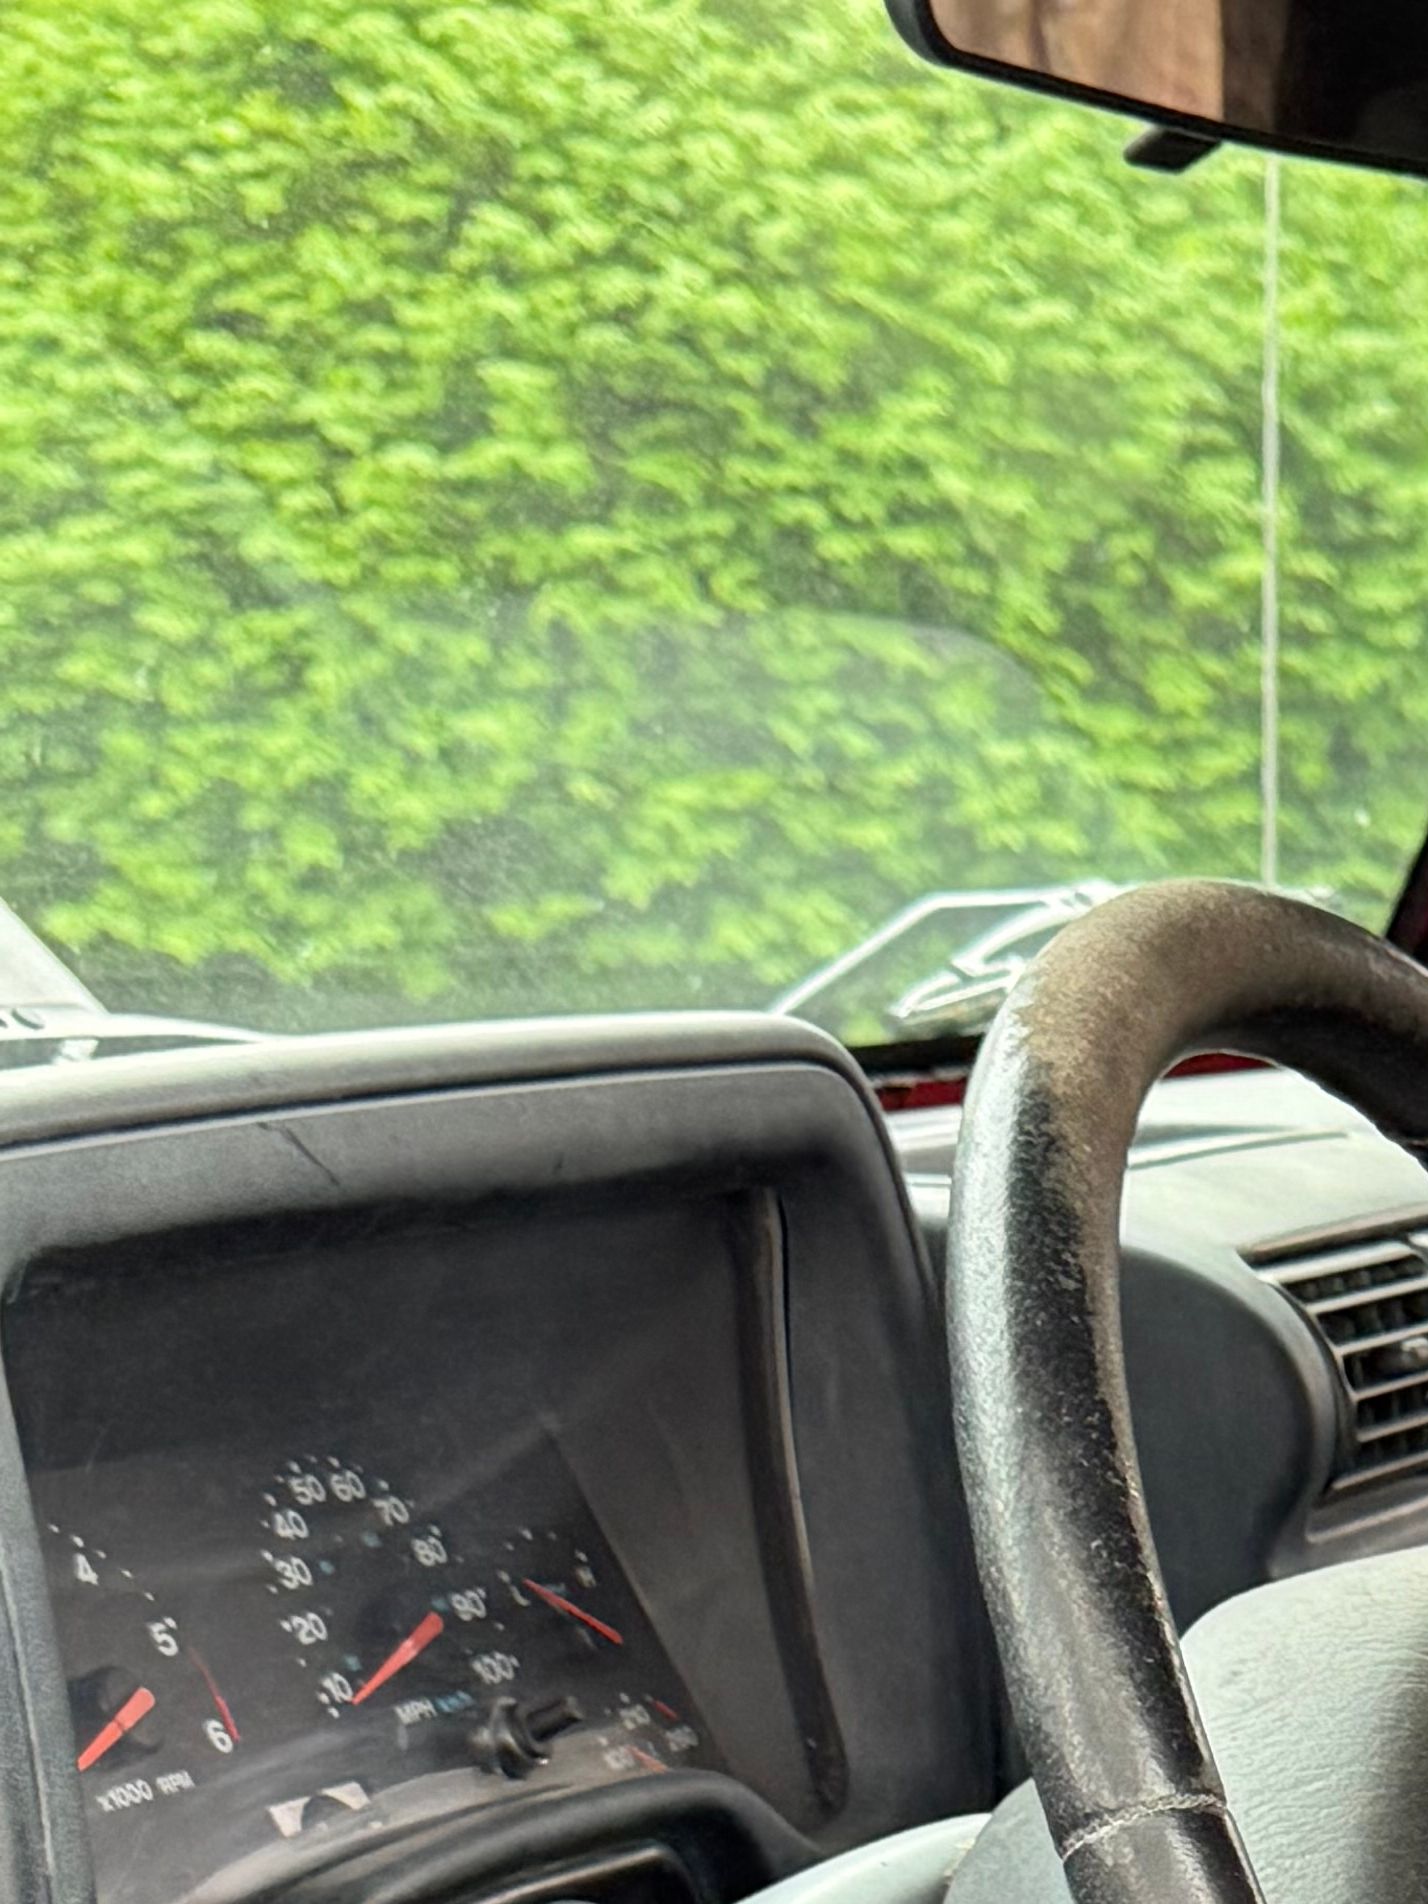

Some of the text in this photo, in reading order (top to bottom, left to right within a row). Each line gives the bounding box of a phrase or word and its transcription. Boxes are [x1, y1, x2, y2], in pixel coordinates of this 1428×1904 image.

[288, 1474, 326, 1505] 50
[330, 1470, 366, 1502] 60
[273, 1509, 310, 1540] 40
[373, 1496, 411, 1526] 70
[411, 1535, 448, 1567] 80
[73, 1552, 99, 1586] 4
[274, 1555, 313, 1589] 30
[148, 1620, 179, 1657] 5
[290, 1612, 328, 1645] 20
[471, 1652, 515, 1684] 100
[320, 1671, 354, 1703] 10
[203, 1718, 235, 1755] 6
[155, 1769, 196, 1796] RPM
